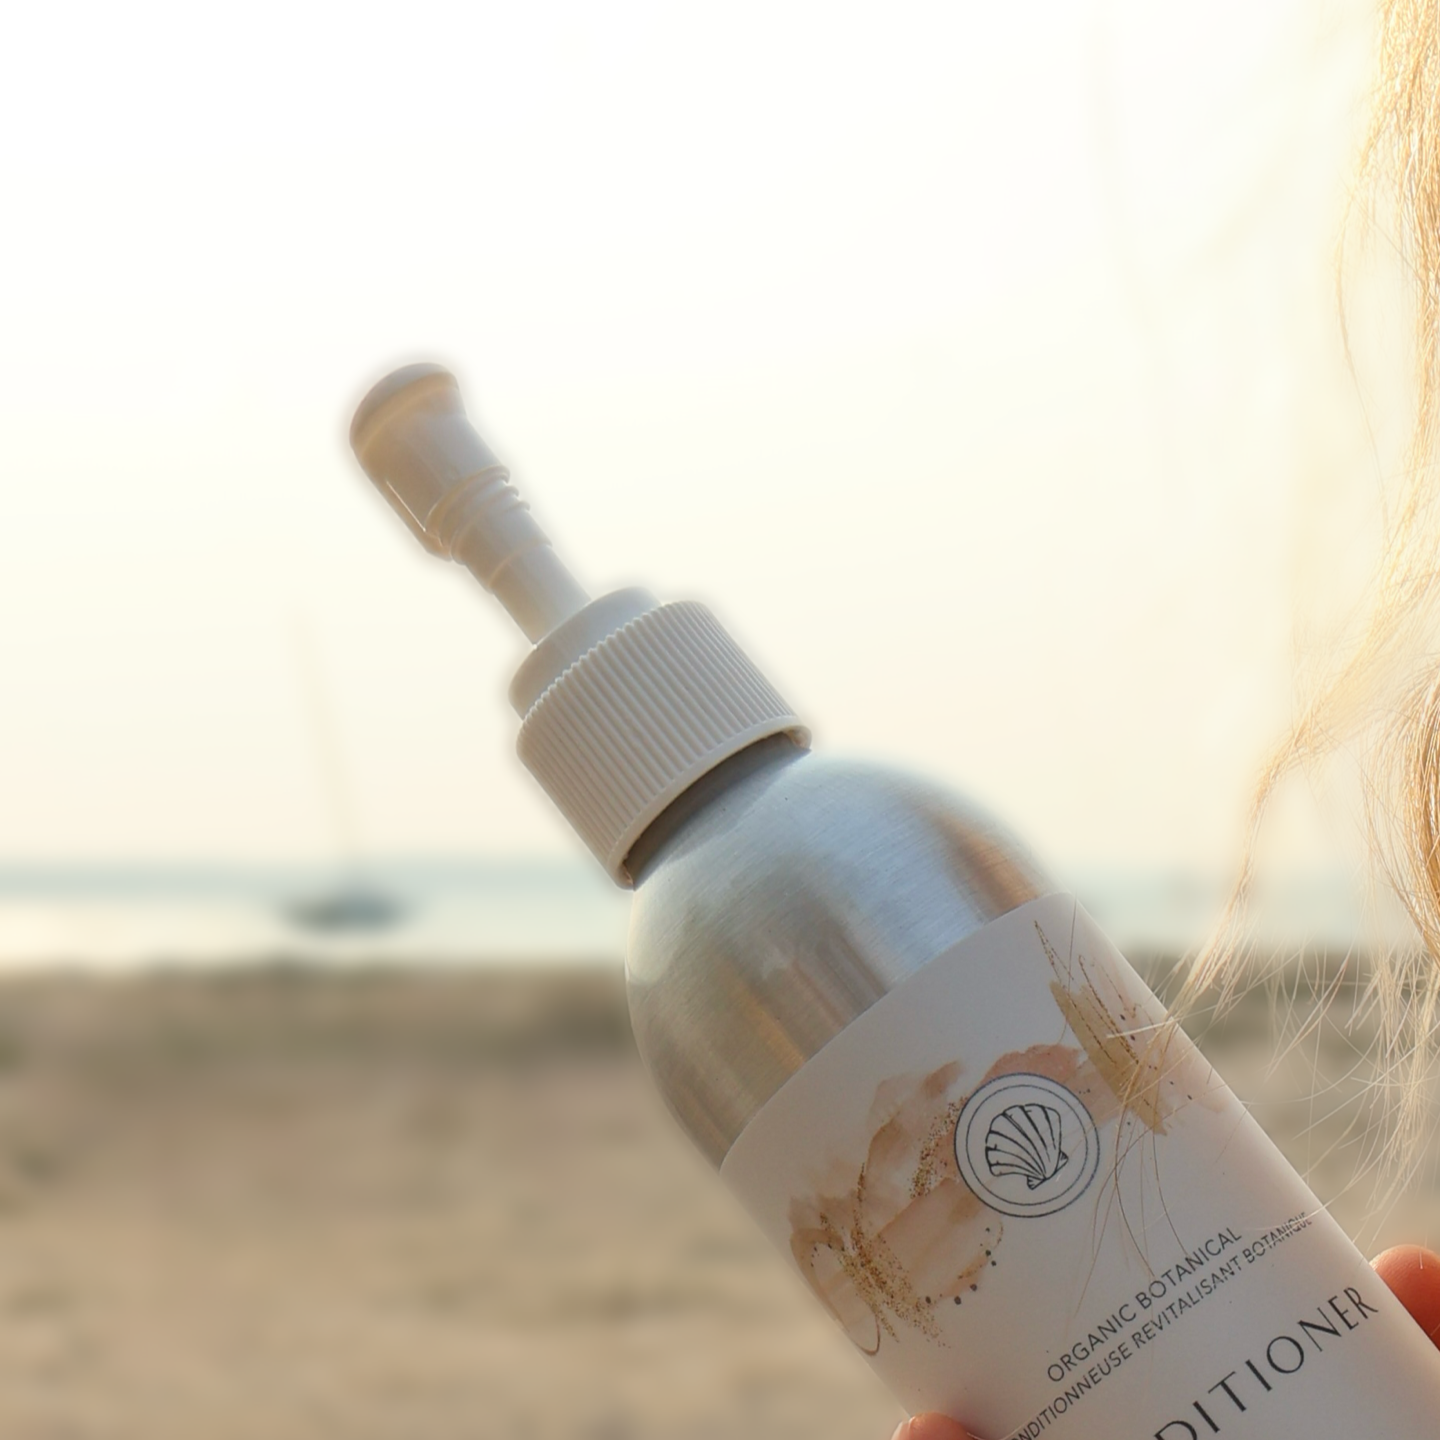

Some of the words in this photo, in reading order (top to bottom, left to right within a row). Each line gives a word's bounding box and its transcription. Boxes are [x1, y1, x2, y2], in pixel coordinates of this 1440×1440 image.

[1047, 1303, 1137, 1382] ORGANIC
[1135, 1227, 1242, 1310] BOTANICAL
[1131, 1256, 1242, 1349] REVITALISANT
[1242, 1212, 1312, 1264] BOTANIQUE
